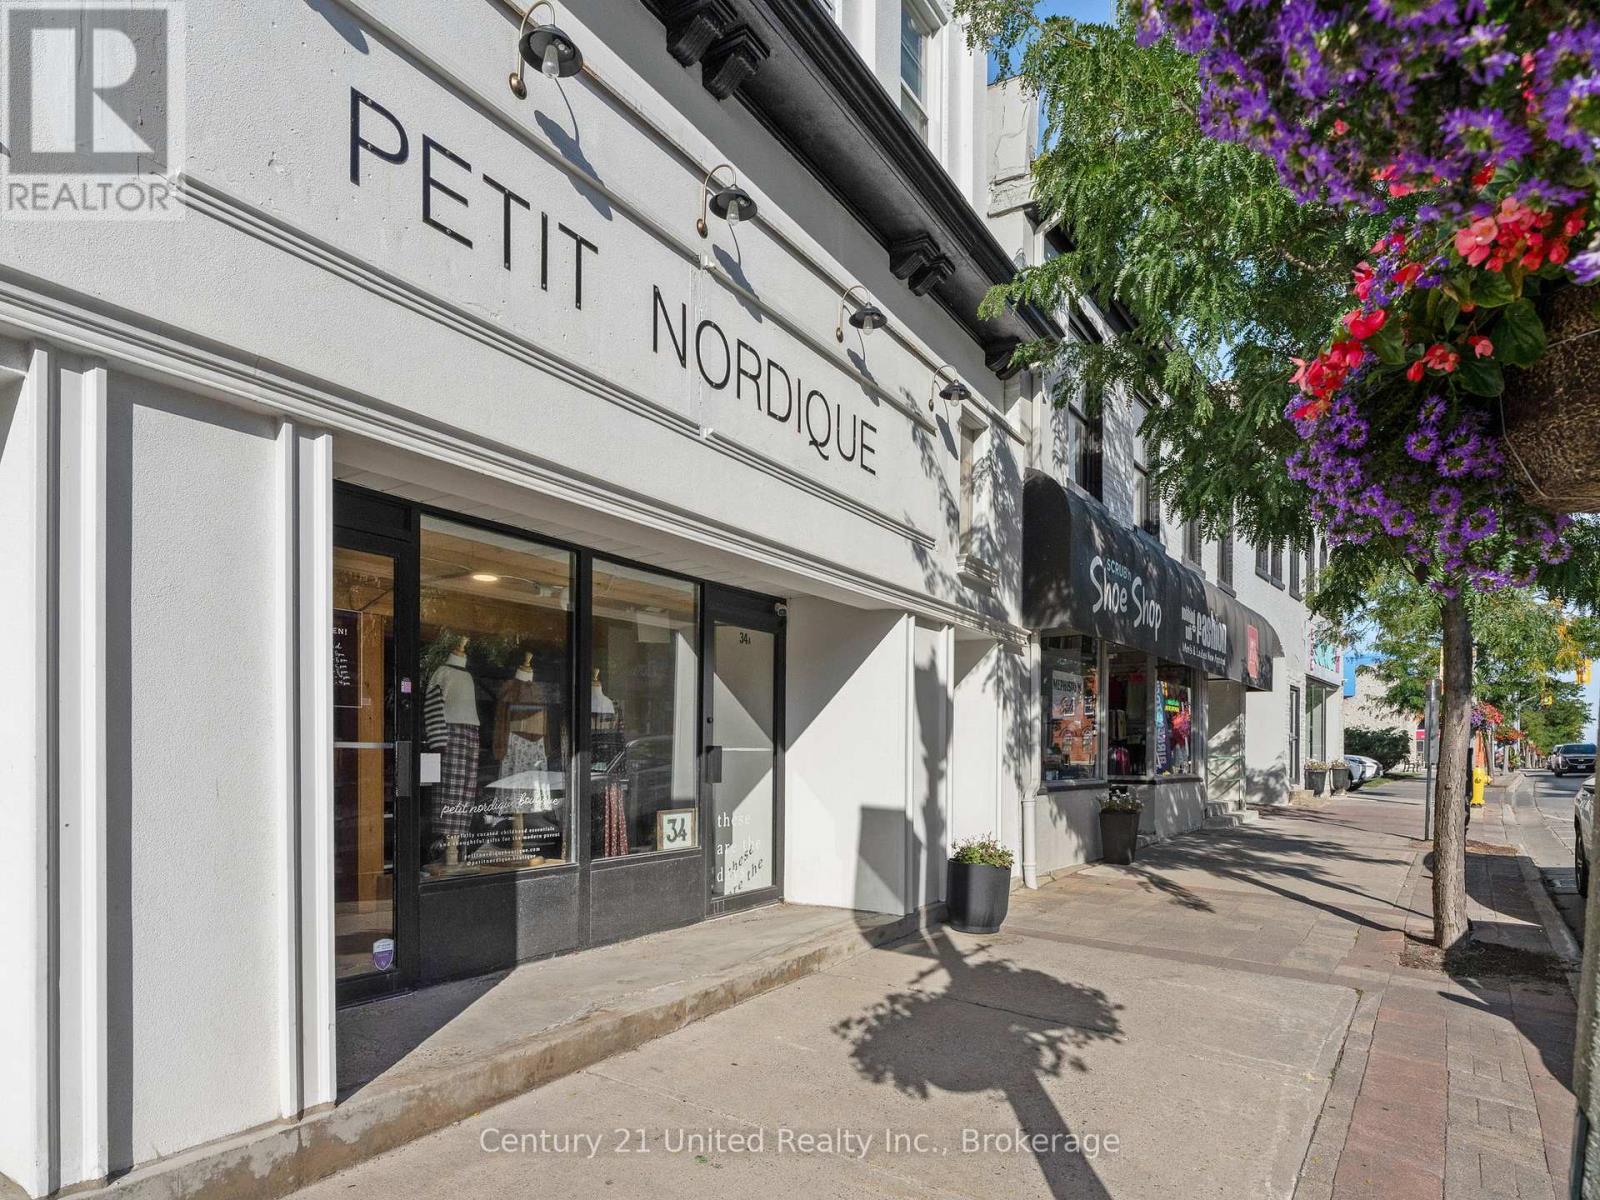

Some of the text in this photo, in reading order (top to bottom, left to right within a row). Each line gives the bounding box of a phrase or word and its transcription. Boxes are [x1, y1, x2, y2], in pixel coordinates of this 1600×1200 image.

[350, 86, 877, 476] PETIT NORDIQUE
[1089, 555, 1162, 642] Shoe Shop
[440, 801, 469, 818] petit
[666, 817, 688, 843] 34
